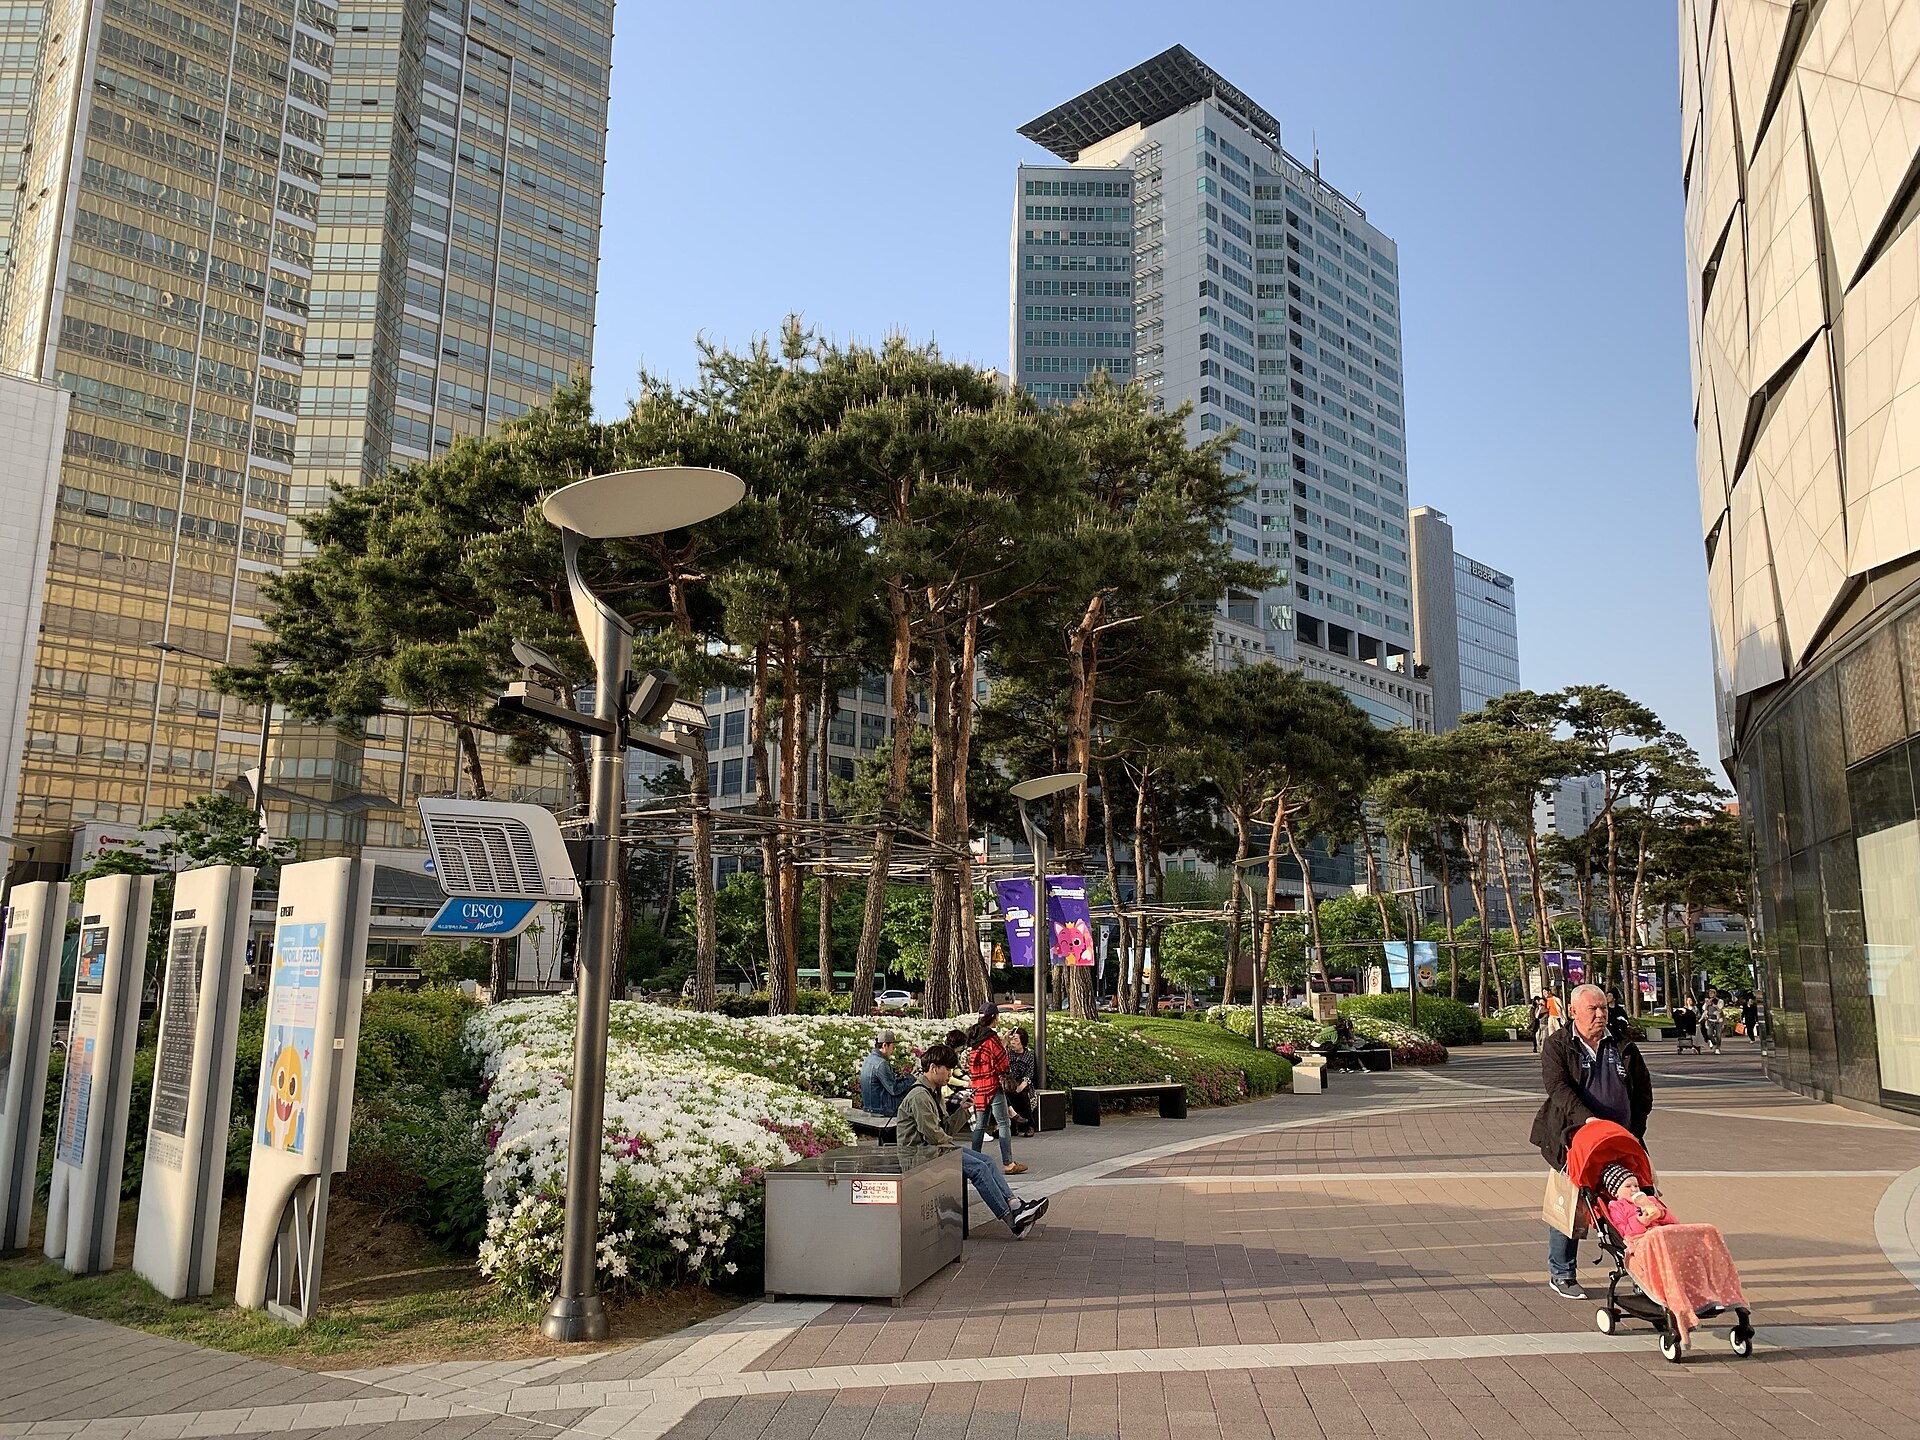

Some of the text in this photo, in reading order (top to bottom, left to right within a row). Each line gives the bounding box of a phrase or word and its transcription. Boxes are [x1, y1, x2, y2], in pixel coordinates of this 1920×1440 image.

[1270, 151, 1306, 193] HALLA
[280, 906, 294, 917] EVENT
[462, 903, 503, 919] CESCO
[282, 948, 320, 963] WORLD FESTA
[862, 1185, 889, 1195] 금연구역
